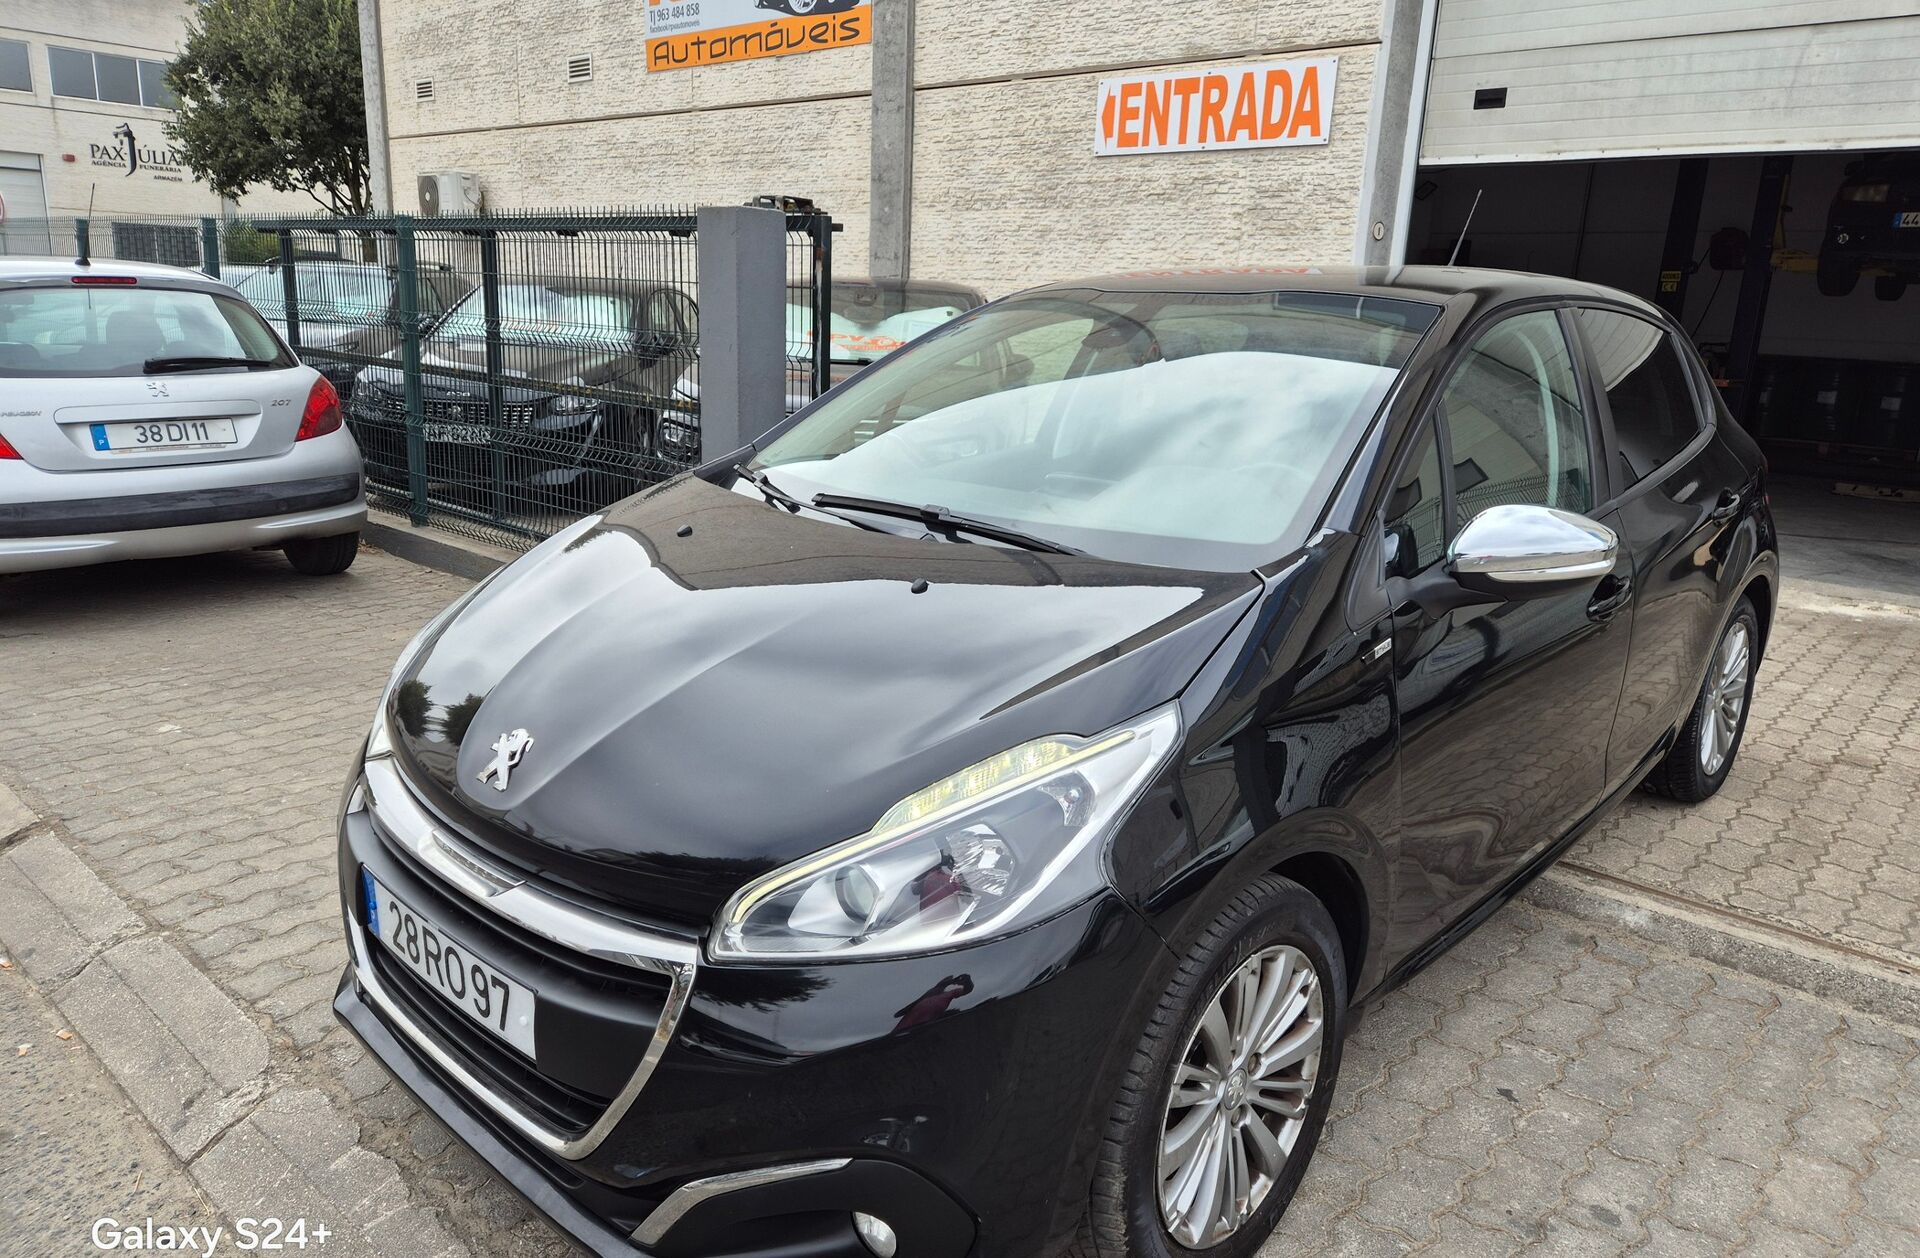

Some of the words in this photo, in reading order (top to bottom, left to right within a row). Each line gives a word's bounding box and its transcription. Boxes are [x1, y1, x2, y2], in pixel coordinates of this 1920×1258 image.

[657, 8, 669, 21] 963
[672, 5, 684, 19] 484
[686, 2, 700, 16] 858
[654, 15, 860, 67] Automóveis
[1117, 66, 1321, 149] ENTRADA
[271, 399, 291, 407] 207
